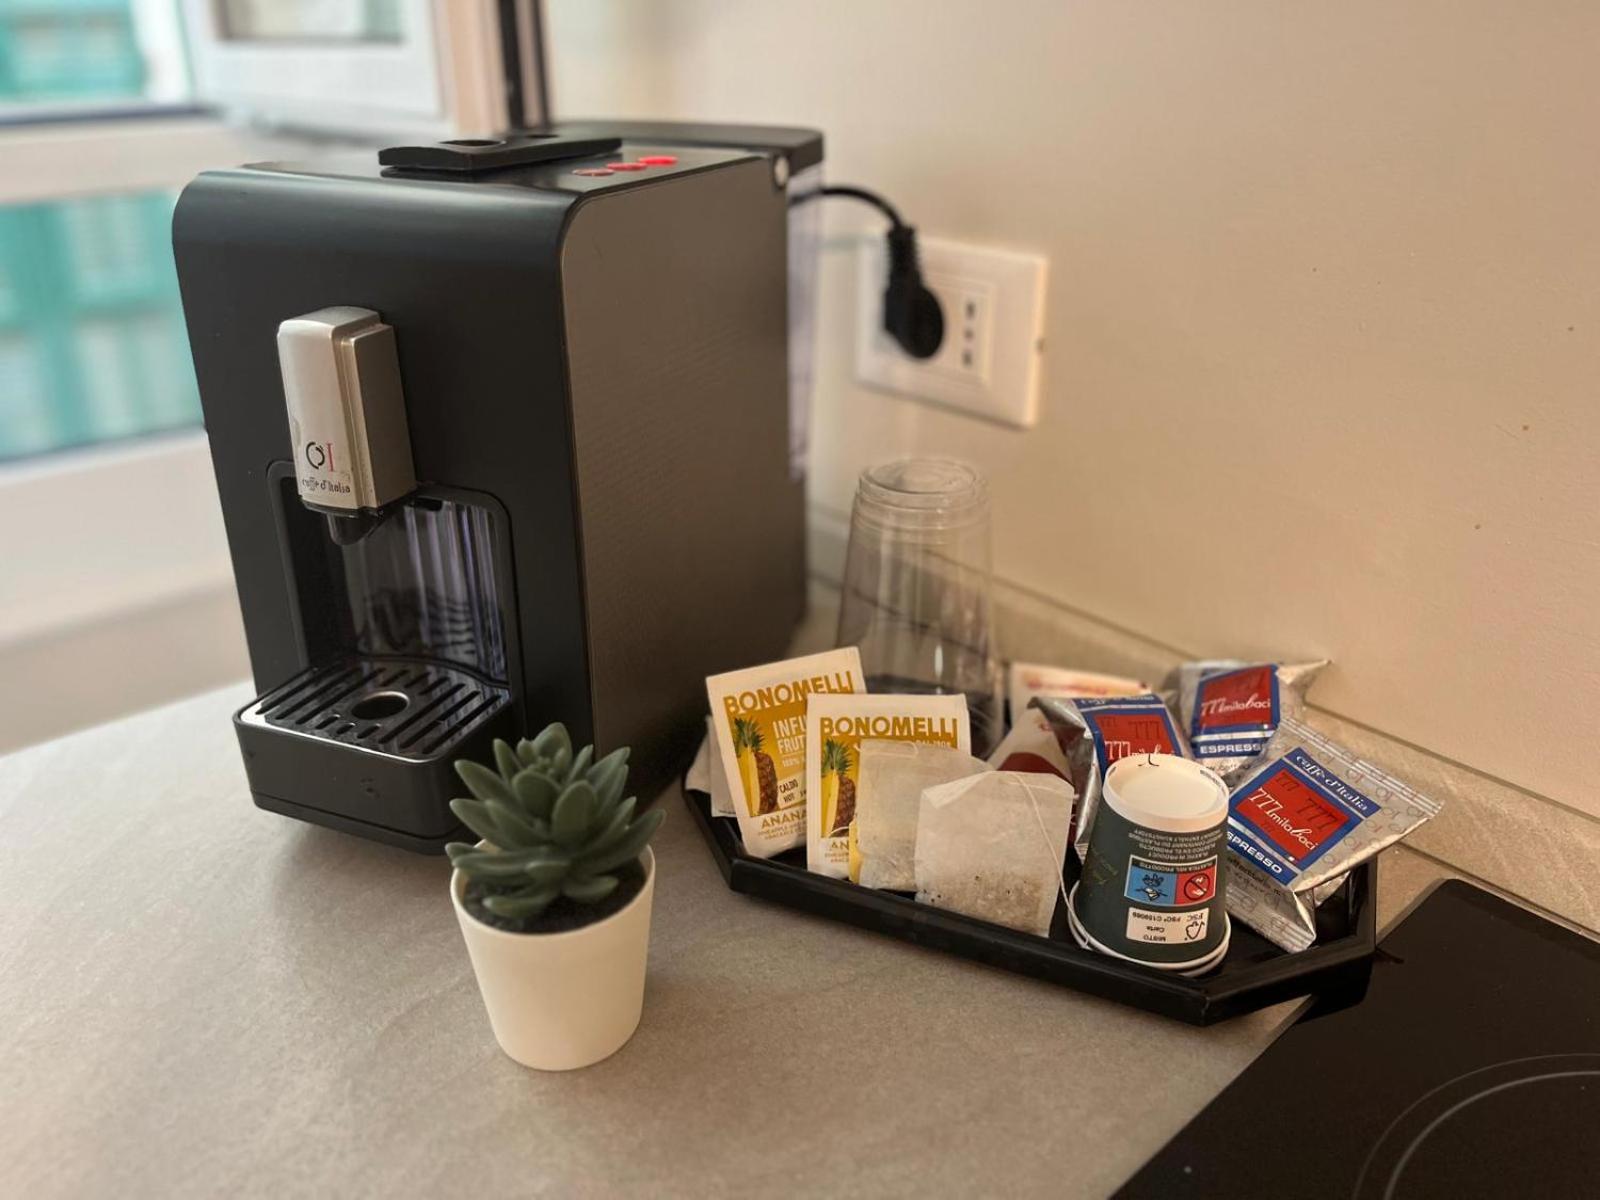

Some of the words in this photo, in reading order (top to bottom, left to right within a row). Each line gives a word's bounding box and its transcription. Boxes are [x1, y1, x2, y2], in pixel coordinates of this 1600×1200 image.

[723, 671, 854, 714] BONOMELLI
[821, 717, 957, 737] BONOMELLI
[1186, 912, 1204, 921] FSC
